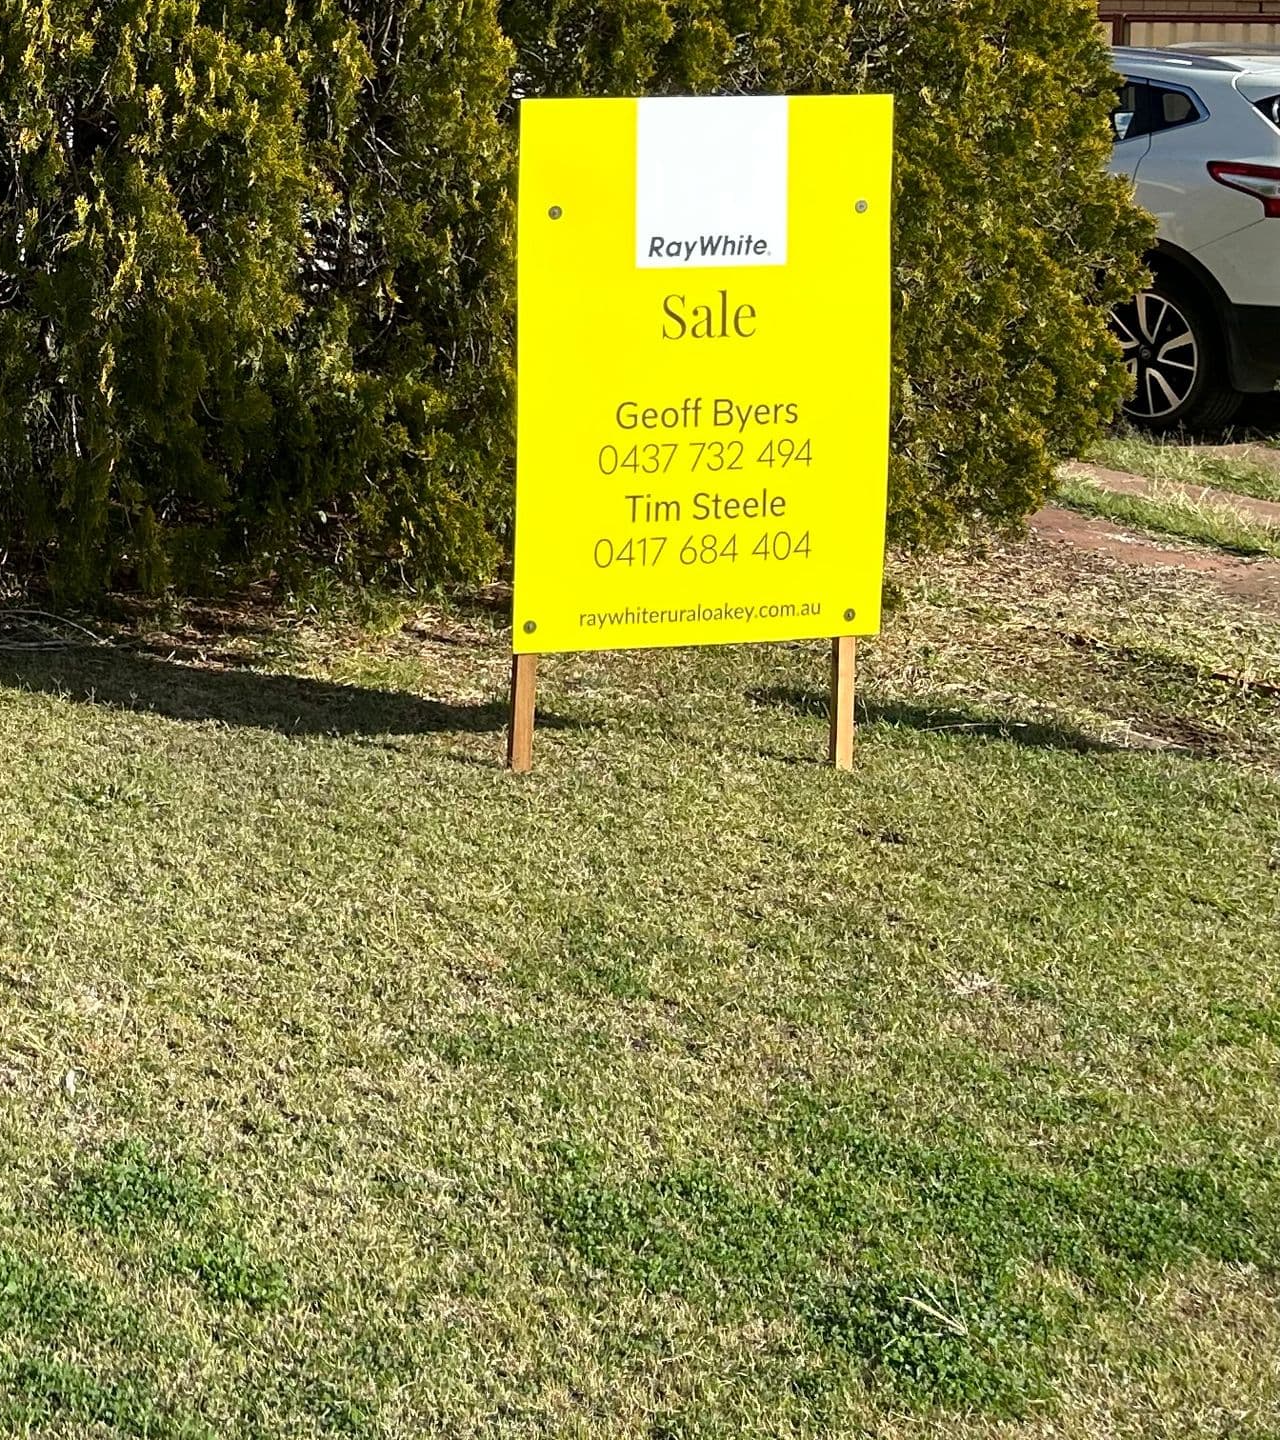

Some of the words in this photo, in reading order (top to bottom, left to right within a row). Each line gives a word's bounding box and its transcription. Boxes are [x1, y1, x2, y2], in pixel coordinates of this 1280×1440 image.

[662, 289, 757, 341] Sale
[615, 397, 703, 430] Geoff
[713, 398, 799, 434] Byers
[598, 443, 679, 476] 0437
[689, 440, 744, 473] 732
[756, 438, 813, 469] 494
[624, 493, 681, 524] Tim
[692, 487, 787, 521] Steele
[593, 536, 668, 569] 0417
[679, 533, 739, 566] 684
[751, 530, 812, 561] 404
[579, 602, 821, 630] raywhiteruraloakey.com.au
